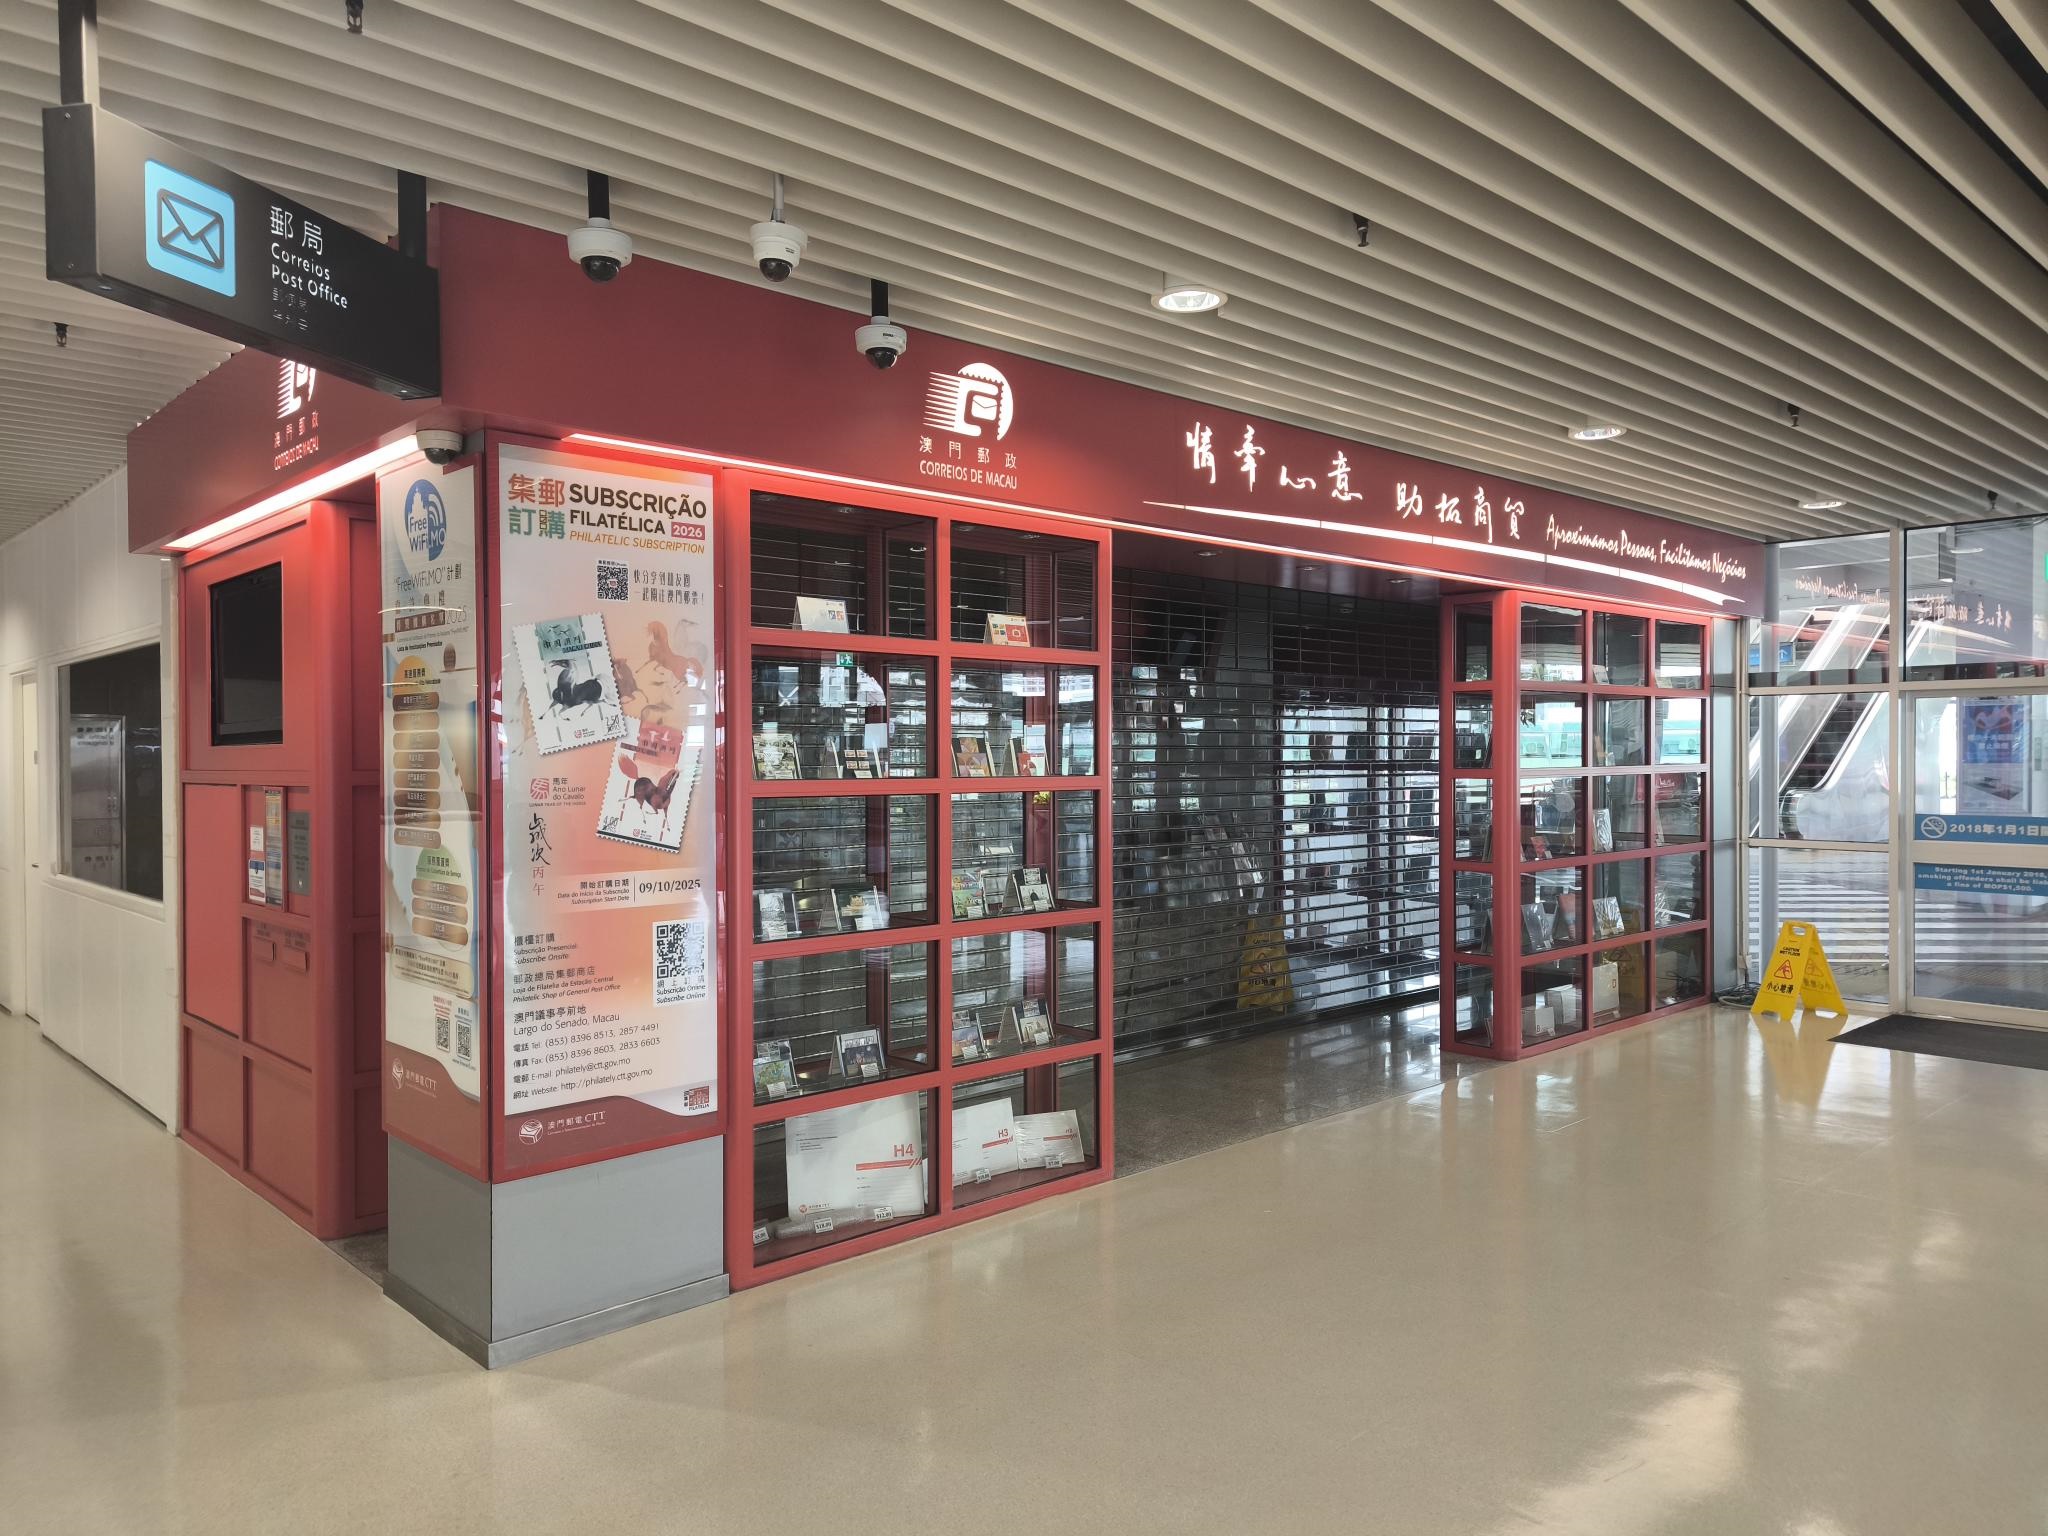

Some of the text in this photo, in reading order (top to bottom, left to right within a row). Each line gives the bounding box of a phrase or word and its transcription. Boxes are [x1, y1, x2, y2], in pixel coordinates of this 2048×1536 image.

[270, 206, 323, 256] 郵局
[271, 242, 330, 280] Correios
[271, 263, 348, 309] Post Office
[919, 435, 1017, 469] 澳門郵政
[919, 460, 1018, 490] CORREIOS DE MACAU
[508, 473, 566, 508] 集郵
[569, 483, 707, 520] SUBSCRIÇÃO
[408, 516, 428, 533] Free
[508, 505, 566, 540] 訂購
[569, 509, 704, 538] FILATÉLICA 2026
[569, 530, 705, 555] PHILATELIC SUBSCRIPTION
[1546, 513, 1747, 583] Aproximamos Pessoas, Facilitamos Negócios
[552, 777, 568, 785] 馬年
[552, 785, 586, 793] Ano Lunar
[552, 793, 585, 801] do Cavalo
[1918, 873, 1952, 881] smoking
[1953, 874, 1994, 883] offenders
[2019, 877, 2030, 885] be
[1934, 866, 1968, 875] Starting
[1986, 869, 2021, 878] January
[579, 889, 594, 898] Início
[603, 887, 630, 896] Subscrição
[580, 878, 629, 890] 開始訂購日期
[639, 878, 701, 895] 09/10/2025
[617, 894, 630, 902] Date
[514, 942, 577, 955] Subscrição Presencial
[514, 952, 569, 965] Subscribe Onsite
[512, 986, 526, 994] Loja
[536, 982, 560, 991] Filatelia
[570, 978, 592, 987] Estação
[593, 976, 614, 984] Central
[512, 994, 540, 1004] Philatelic
[541, 991, 558, 1000] Shop
[558, 989, 565, 997] of
[566, 987, 590, 997] General
[604, 983, 621, 991] Office
[656, 985, 686, 996] Subscrição
[656, 992, 706, 1004] Subscribe Online
[513, 1005, 587, 1024] 澳門議事亭前地
[513, 1013, 620, 1037] Largo do Senado, Macau
[513, 1042, 529, 1053] 電話
[545, 1036, 568, 1049] (853)
[570, 1033, 592, 1043] 8396
[593, 1029, 616, 1040] 8513,
[619, 1026, 639, 1036] 2857
[640, 1022, 659, 1032] 4491
[513, 1058, 529, 1069] 傳真
[545, 1051, 568, 1064] (853)
[570, 1048, 592, 1059] 8396
[593, 1044, 616, 1055] 8603,
[619, 1040, 639, 1051] 2833
[640, 1037, 661, 1047] 6603
[513, 1073, 530, 1084] 電郵
[555, 1057, 631, 1078] philately@ctt.gov.mo
[513, 1090, 529, 1100] 網址
[560, 1068, 653, 1091] http://philately.ctt.gov.mo
[584, 1110, 606, 1122] CTT
[998, 1128, 1009, 1139] H3
[893, 1143, 915, 1158] H4
